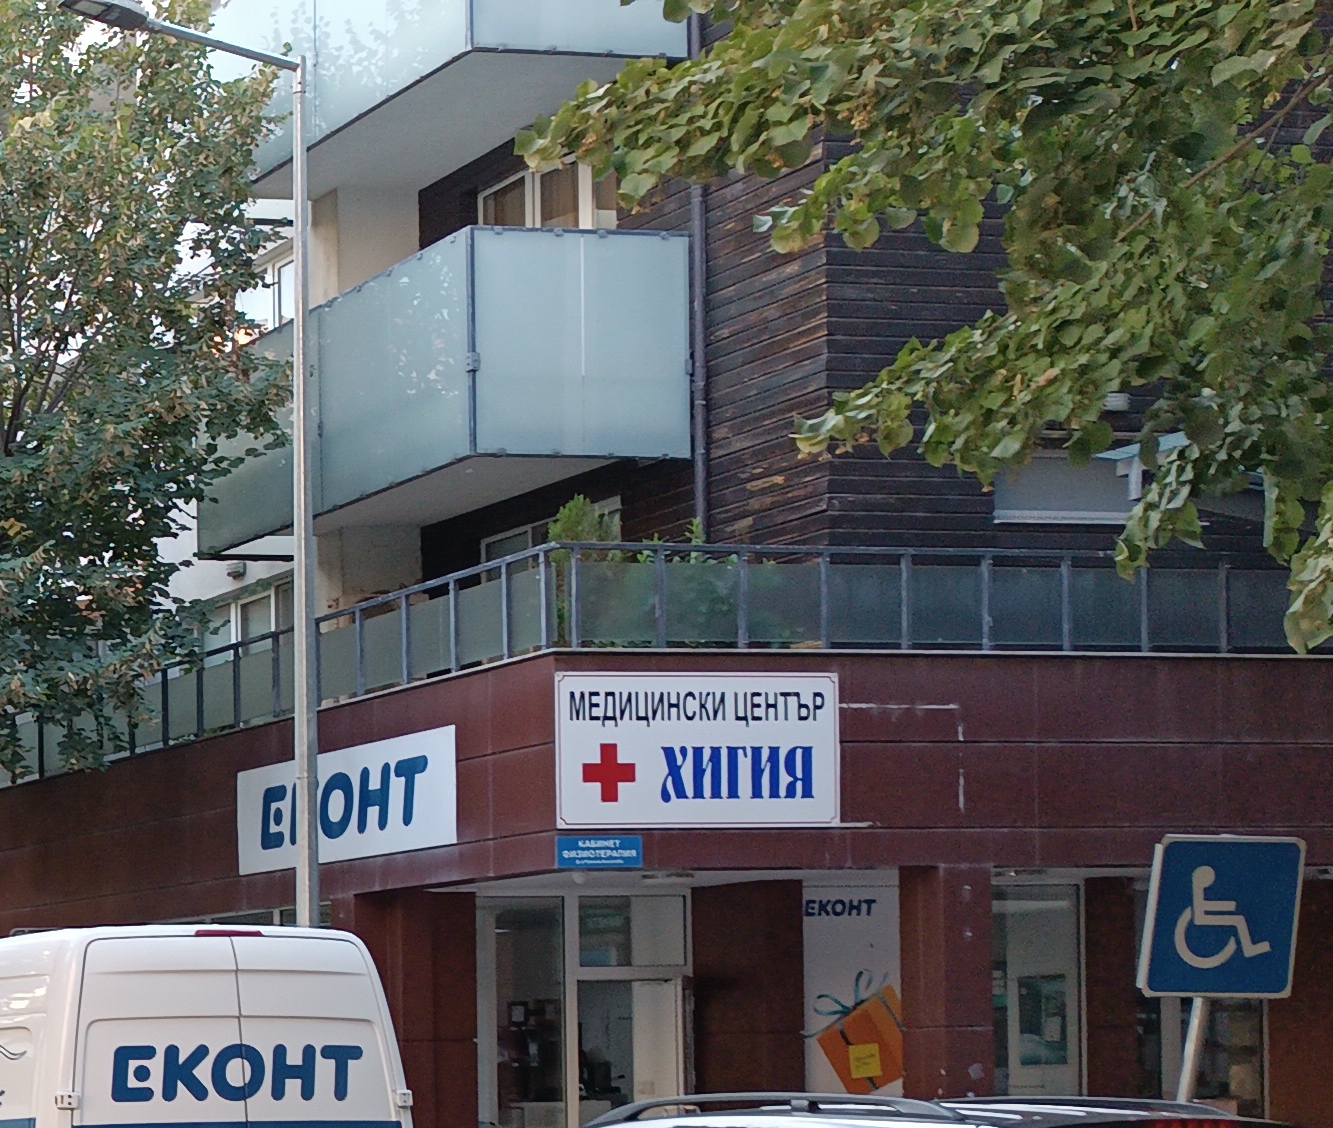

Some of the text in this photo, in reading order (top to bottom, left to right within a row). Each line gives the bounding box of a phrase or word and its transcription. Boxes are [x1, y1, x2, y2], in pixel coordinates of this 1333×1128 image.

[569, 691, 825, 727] МЕДИЦИНСКИ ЦЕНТЪР
[261, 754, 428, 850] ЕОНТ
[660, 745, 814, 803] ХИГИЯ
[803, 898, 877, 917] ЕКОНТ
[111, 1044, 363, 1102] ЕКОНТ
